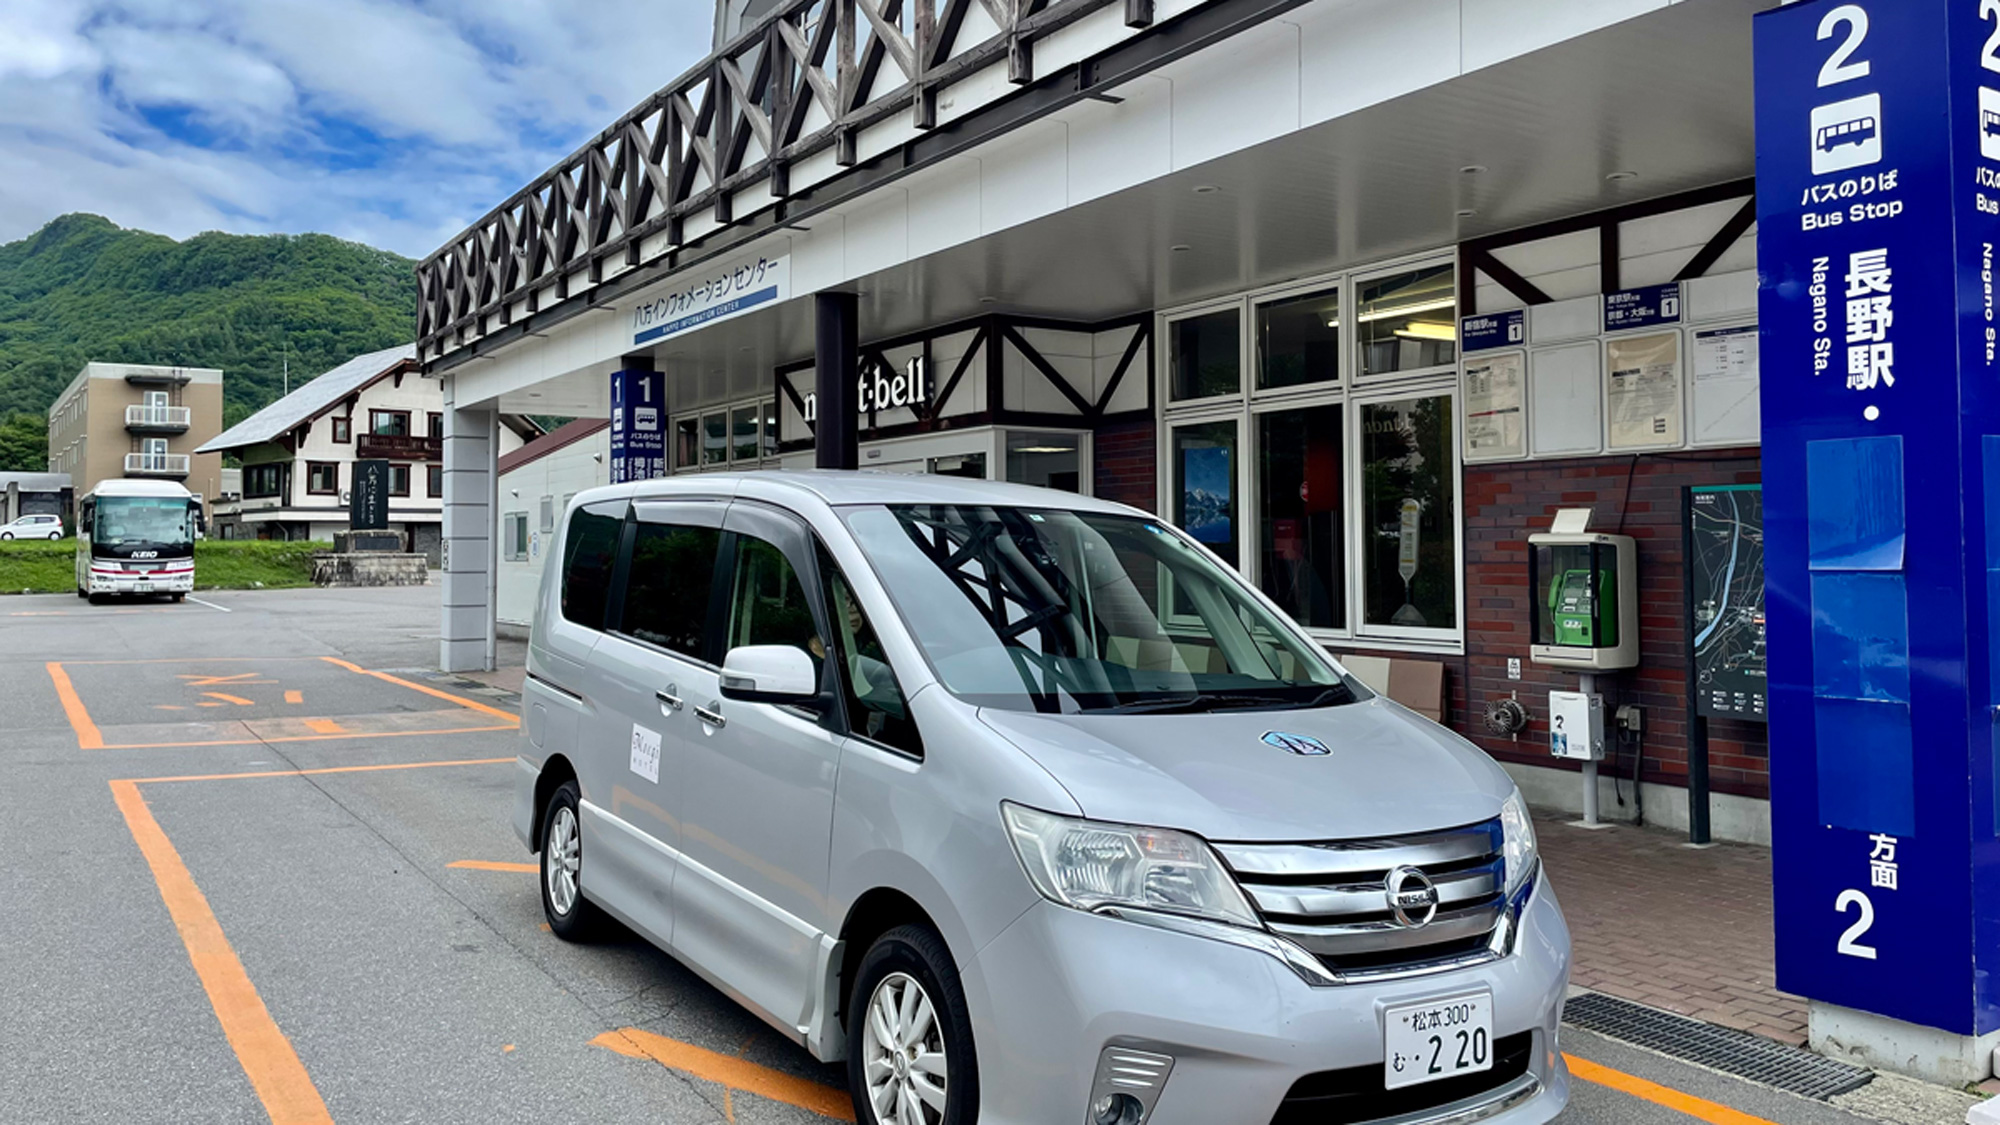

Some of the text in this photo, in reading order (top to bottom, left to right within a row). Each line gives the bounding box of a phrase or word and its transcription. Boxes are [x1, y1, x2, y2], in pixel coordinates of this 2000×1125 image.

[1816, 4, 1870, 88] 2
[1979, 0, 2000, 73] 2
[1801, 168, 1898, 206] バスのりば
[1976, 193, 1999, 215] Bus
[1801, 200, 1903, 231] Bus Stop
[633, 256, 778, 328] 八方インフォメーションセンター
[716, 300, 740, 316] CENTER
[1666, 300, 1672, 314] 1
[1981, 242, 1996, 366] Nagano Sta.
[1809, 256, 1832, 376] Nagano Sta.
[614, 377, 621, 402] 1
[638, 377, 651, 402] 1
[131, 551, 158, 559] KEIO
[1869, 833, 1898, 891] 方面
[1835, 888, 1877, 960] 2
